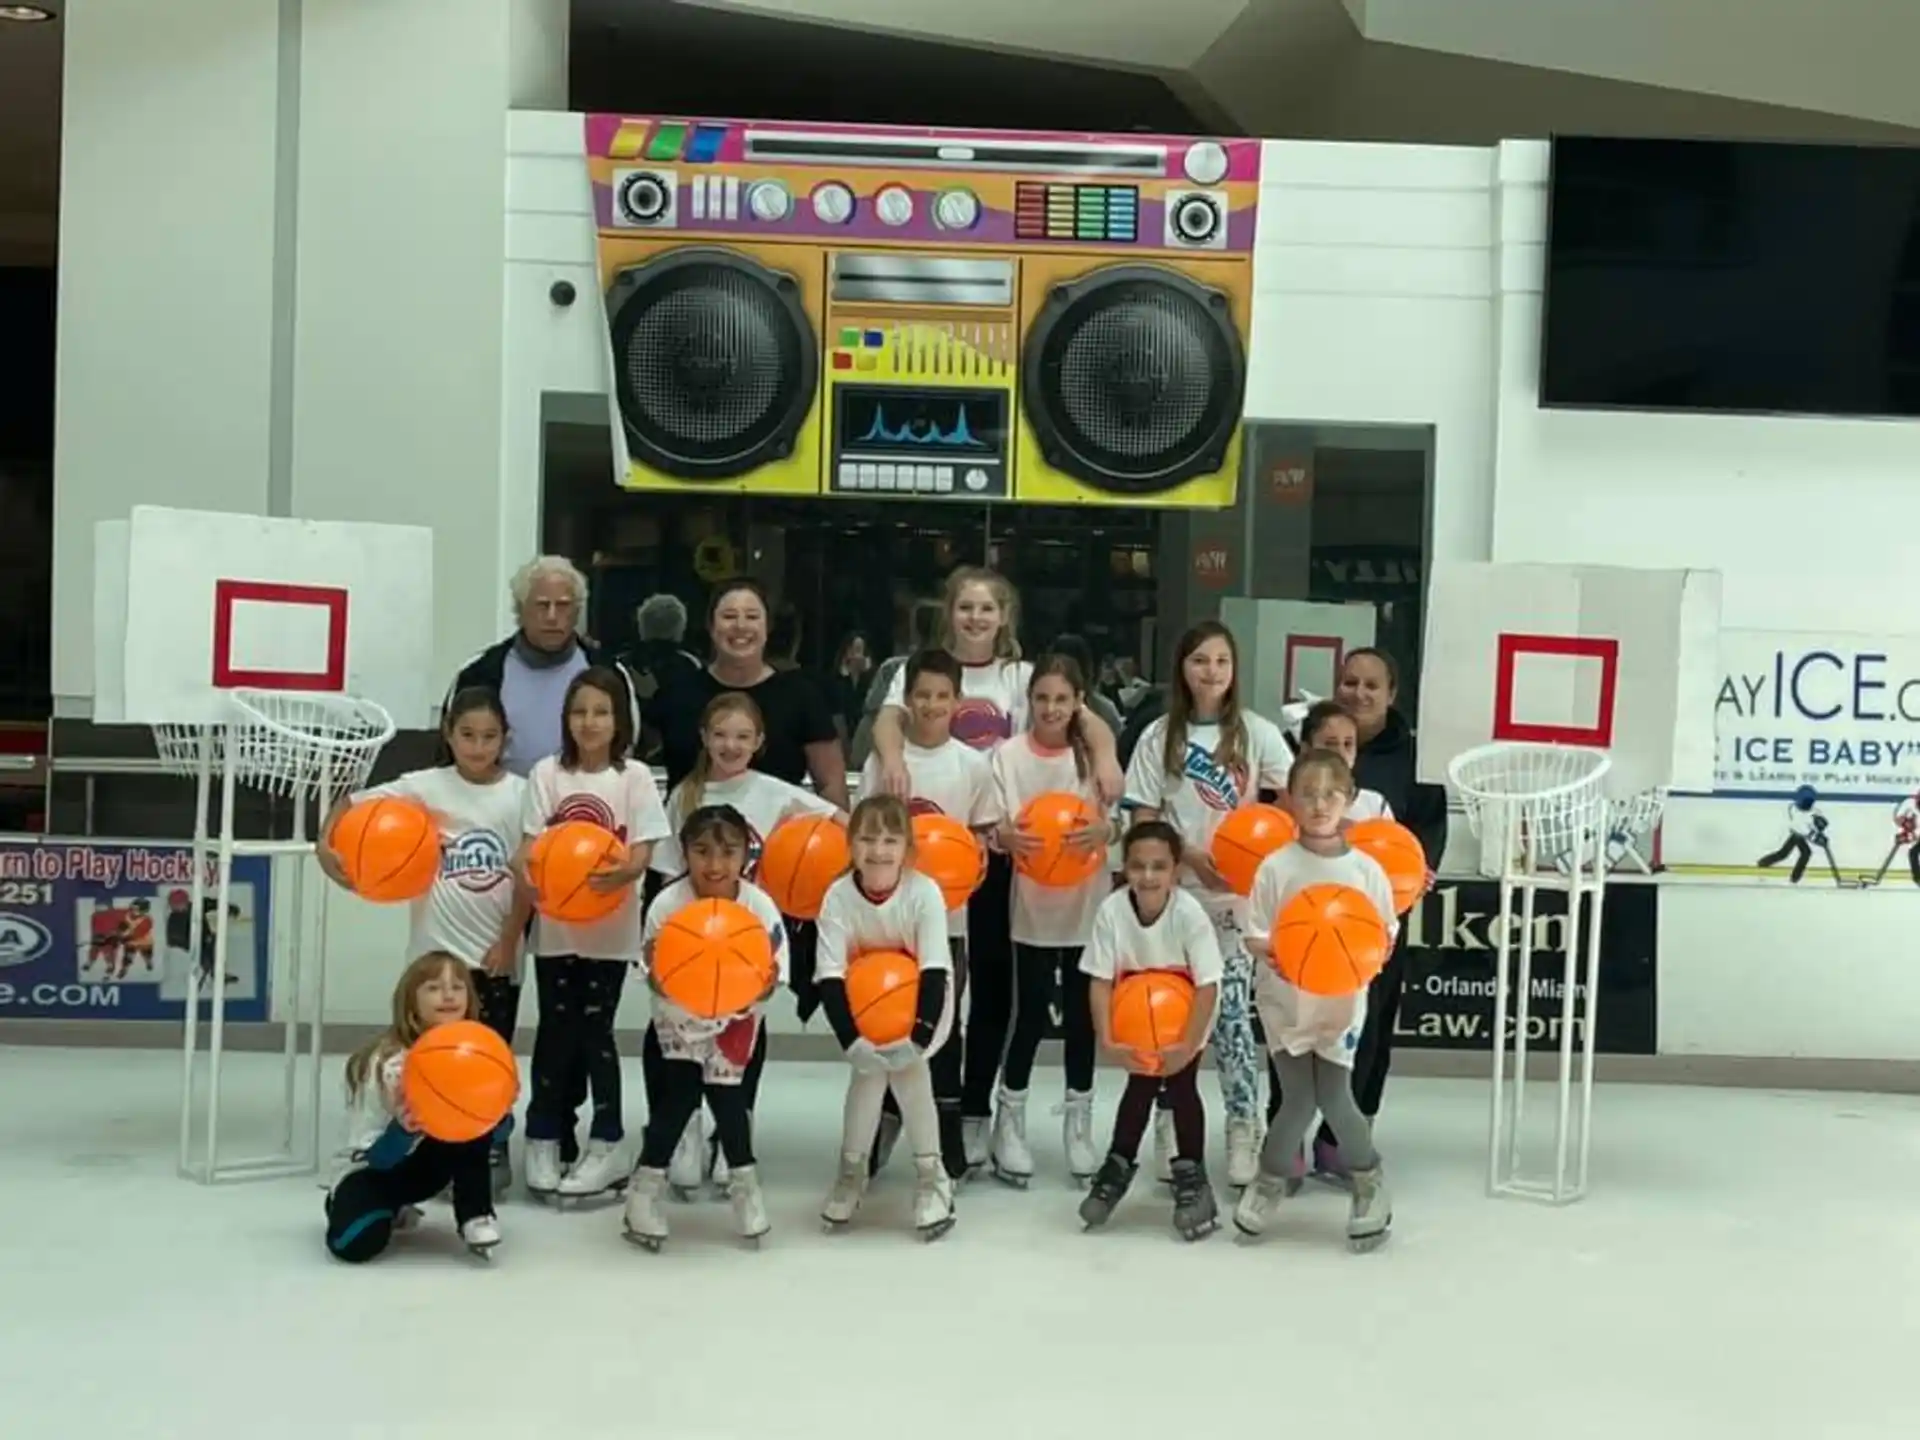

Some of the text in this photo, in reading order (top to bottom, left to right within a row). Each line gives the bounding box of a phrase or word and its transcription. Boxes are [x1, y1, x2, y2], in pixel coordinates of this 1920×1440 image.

[1734, 737, 1794, 763] ICE
[33, 848, 62, 879] to
[66, 847, 122, 889] Play
[126, 848, 222, 888] Hocky
[1531, 978, 1592, 998] Miam
